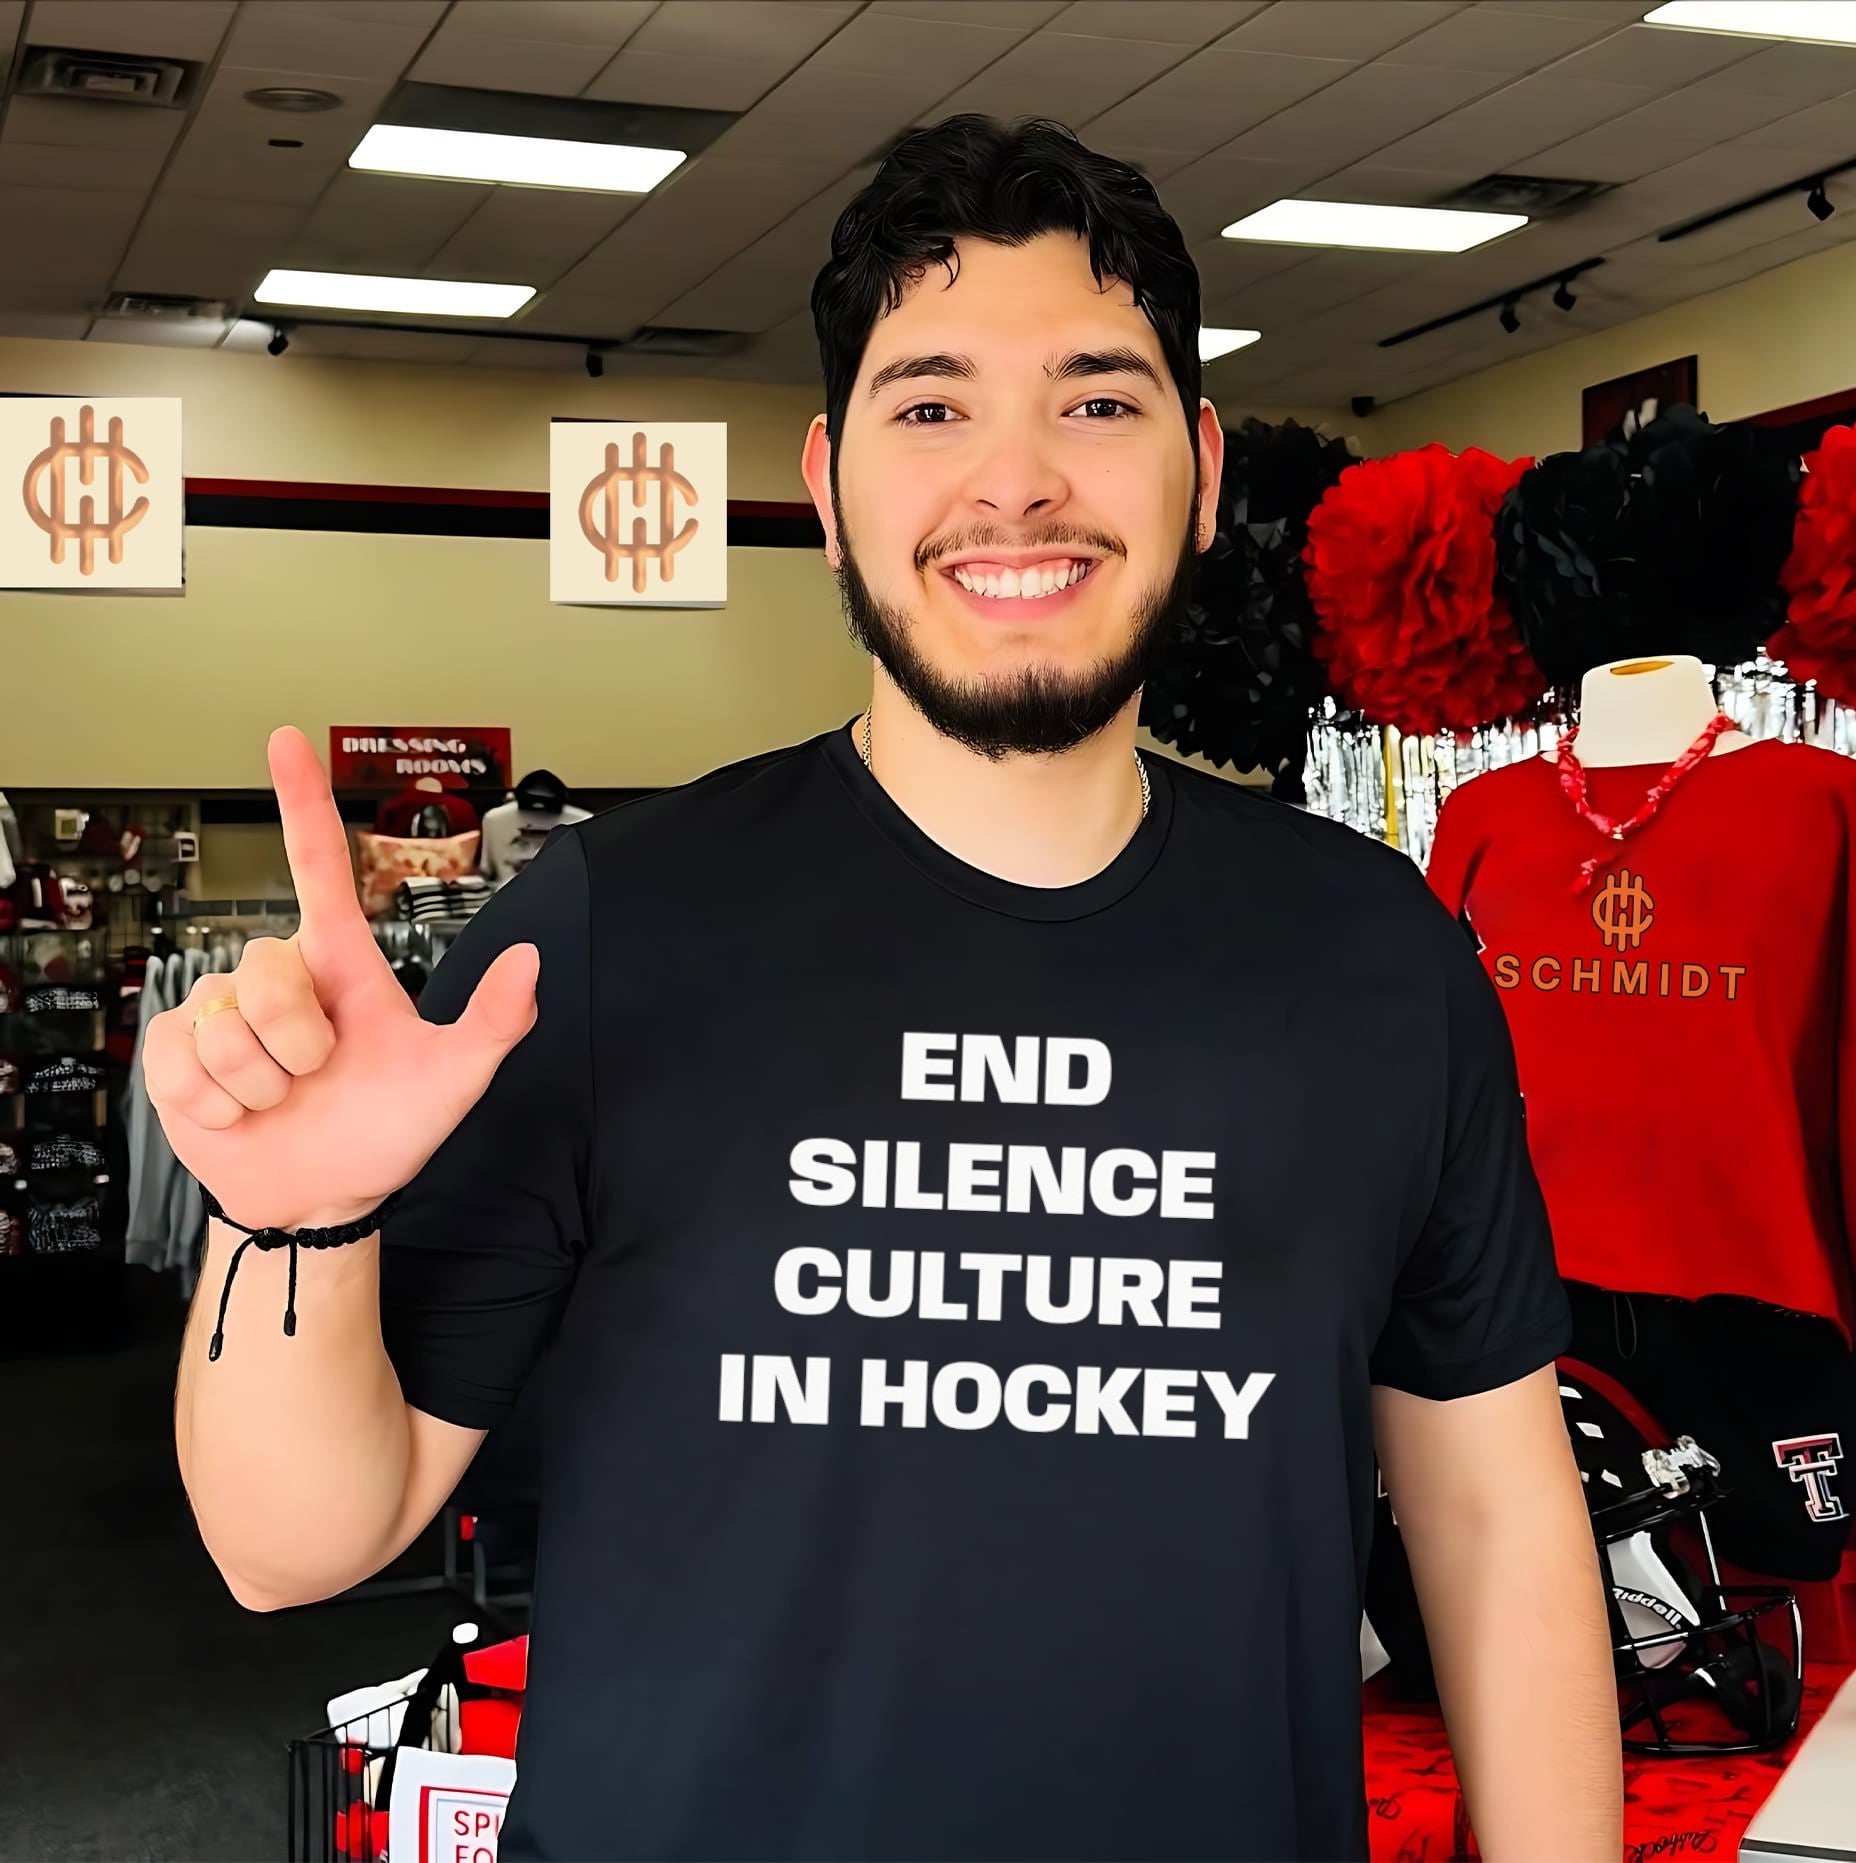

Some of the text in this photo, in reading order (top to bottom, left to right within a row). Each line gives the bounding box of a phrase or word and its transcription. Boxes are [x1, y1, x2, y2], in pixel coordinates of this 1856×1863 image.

[342, 737, 467, 754] DRESSING
[396, 758, 487, 775] ROOMS
[1494, 954, 1747, 1000] SCHMIDT
[901, 1031, 1113, 1106] END
[789, 1137, 1217, 1219] SILENCE
[774, 1246, 1223, 1329] CULTURE
[719, 1353, 1277, 1440] IN HOCKEY
